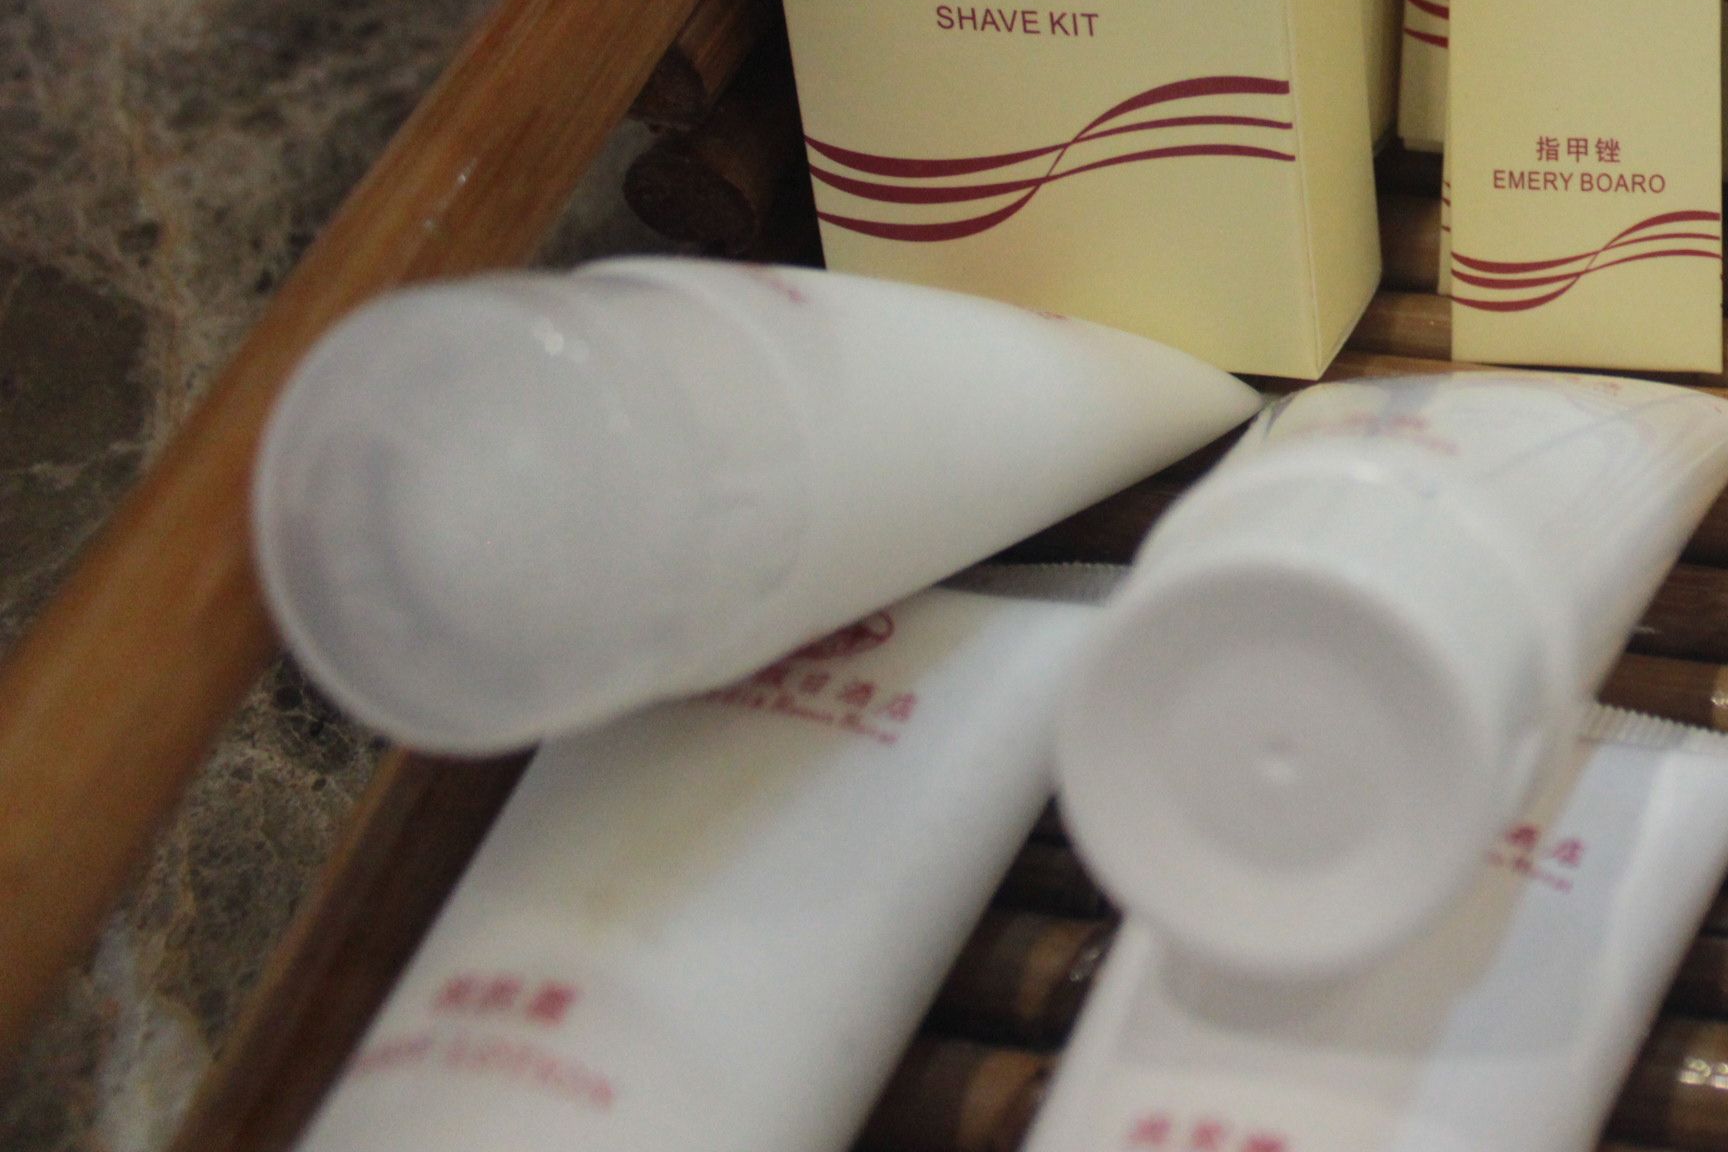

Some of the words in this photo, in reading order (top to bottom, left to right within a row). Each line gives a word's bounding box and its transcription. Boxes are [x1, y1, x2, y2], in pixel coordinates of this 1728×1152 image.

[936, 5, 1041, 35] SHAVE
[1049, 10, 1099, 37] KIT
[1536, 135, 1621, 164] 指甲锉
[1493, 169, 1574, 191] EMERY
